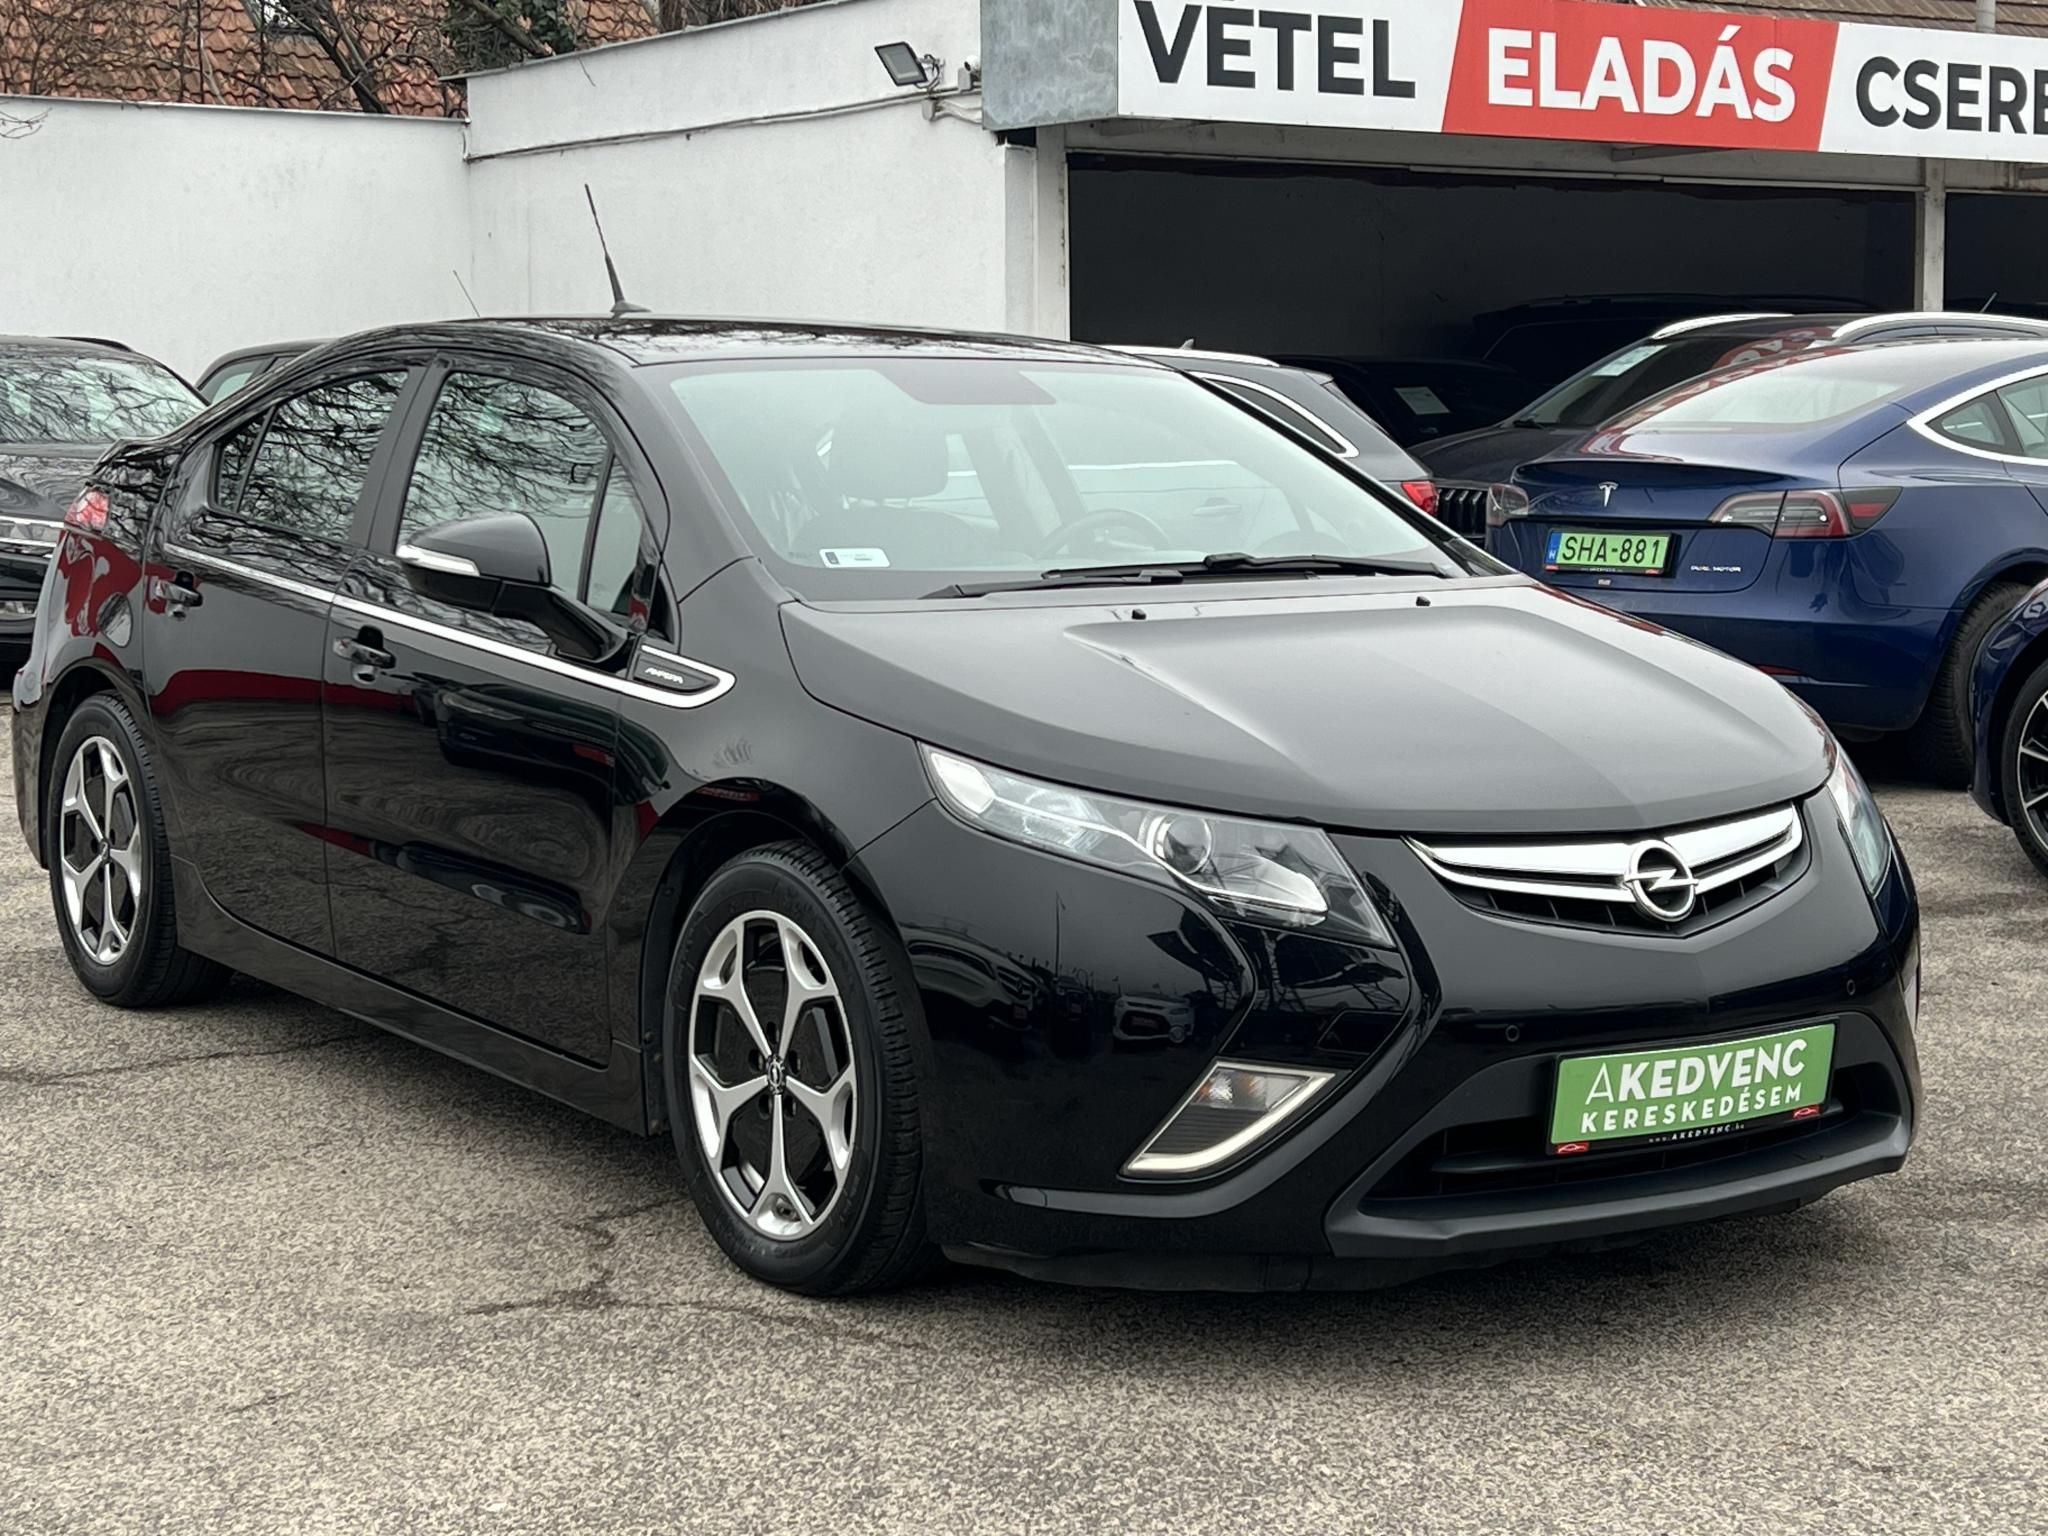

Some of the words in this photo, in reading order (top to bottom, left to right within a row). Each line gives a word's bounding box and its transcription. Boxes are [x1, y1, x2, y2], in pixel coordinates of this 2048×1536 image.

[1488, 25, 1796, 122] ELADÁS
[1562, 536, 1661, 564] SHA-881
[1581, 1082, 1801, 1133] KERESKEDÉSEM
